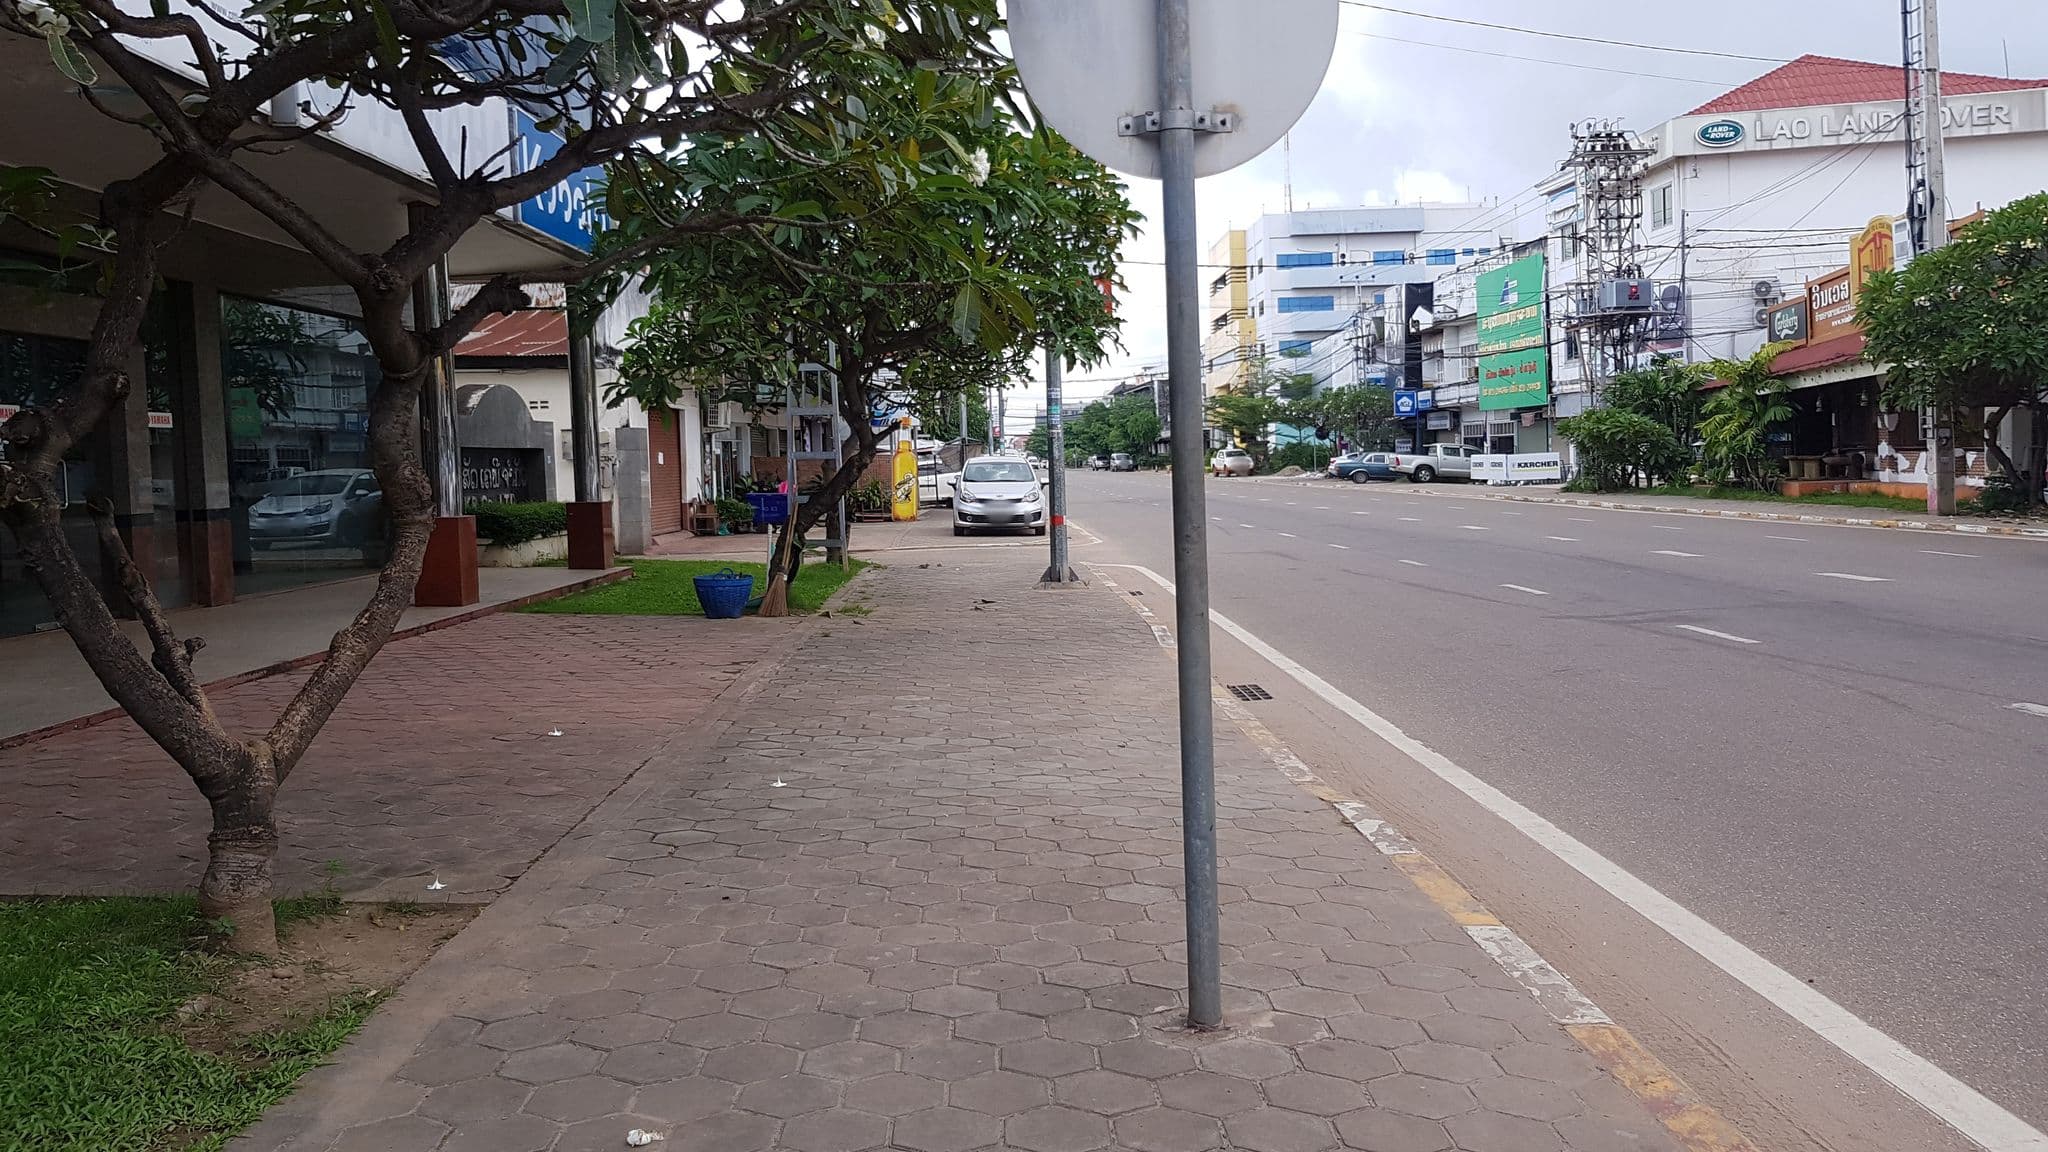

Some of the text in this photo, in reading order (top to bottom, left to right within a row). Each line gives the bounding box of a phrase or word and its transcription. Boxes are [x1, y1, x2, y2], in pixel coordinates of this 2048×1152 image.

[1754, 103, 2011, 141] LAO LAND OVER
[1774, 310, 1798, 336] Carlsberg
